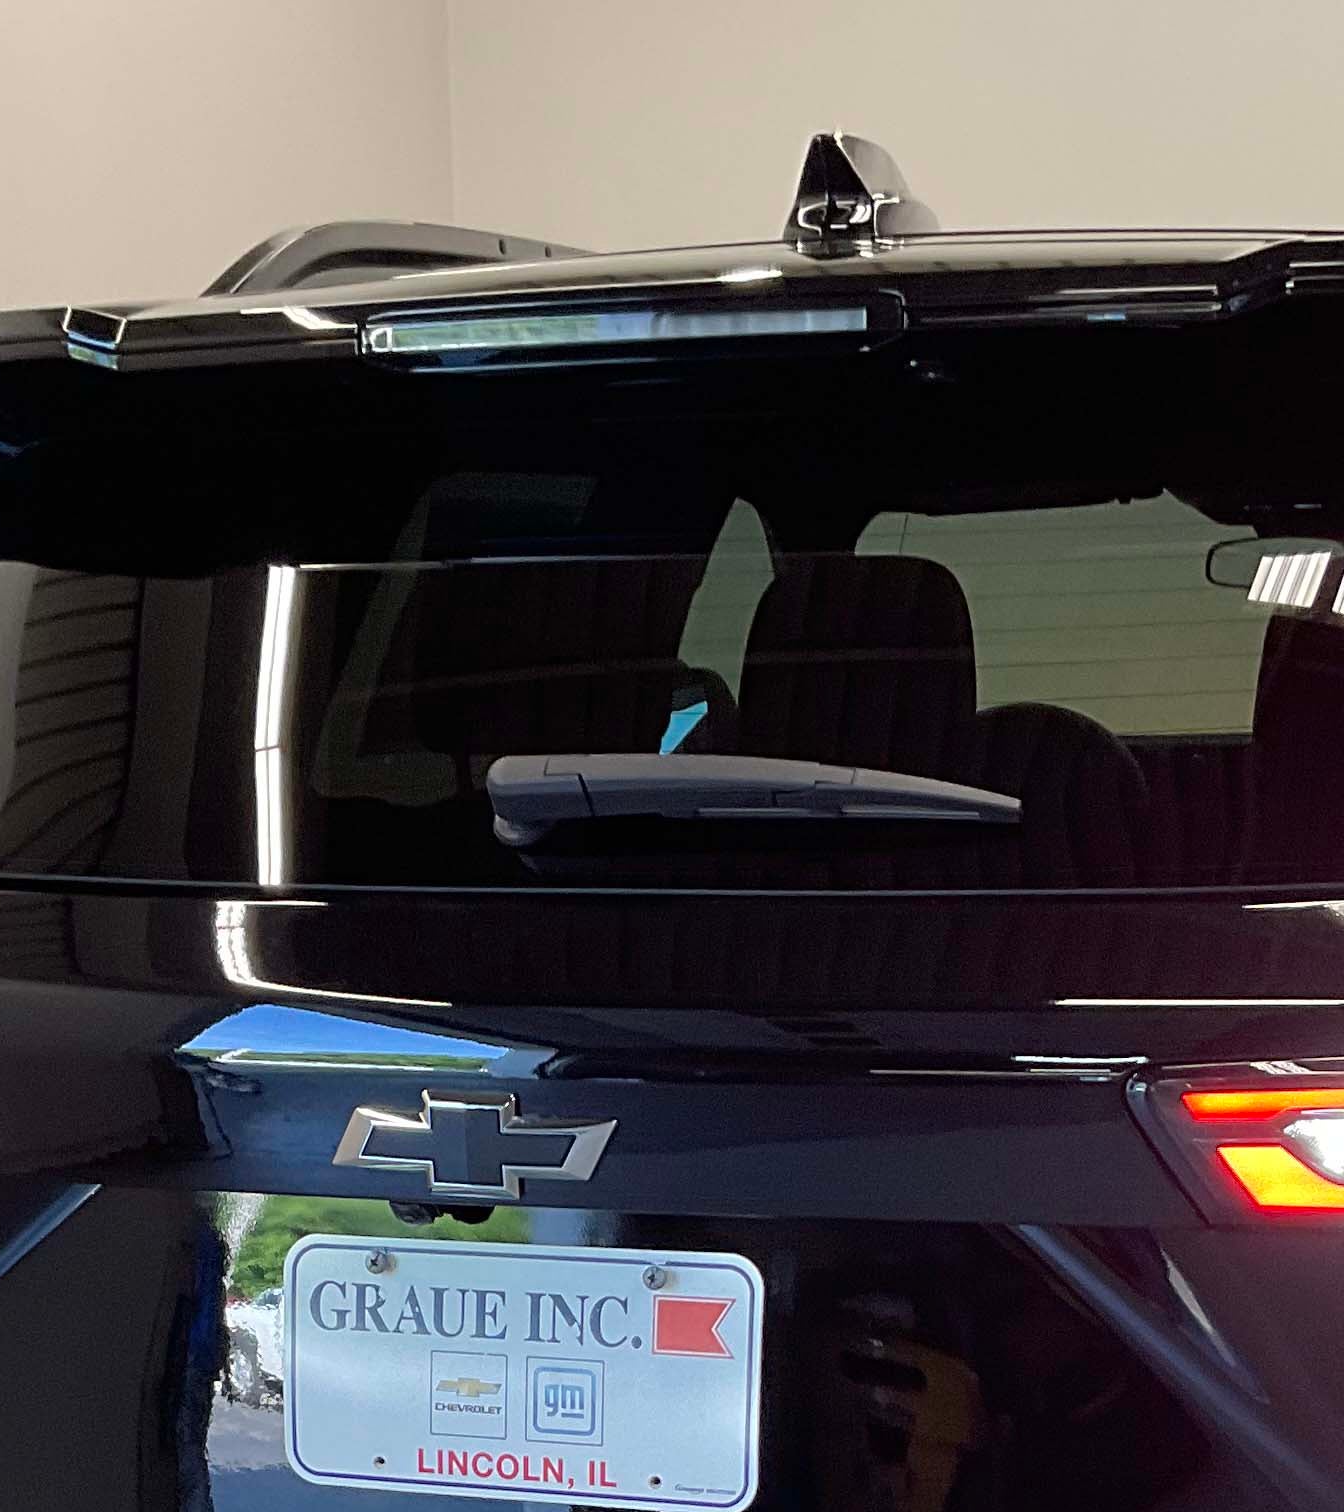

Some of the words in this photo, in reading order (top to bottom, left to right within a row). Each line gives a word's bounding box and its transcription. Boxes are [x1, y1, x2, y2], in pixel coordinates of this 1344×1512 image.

[309, 1280, 507, 1340] GRAUE
[524, 1291, 643, 1350] INC.
[434, 1402, 503, 1415] CHEVROLET
[544, 1384, 585, 1419] gm
[417, 1448, 575, 1489] LINCOLN,
[589, 1460, 617, 1488] IL
